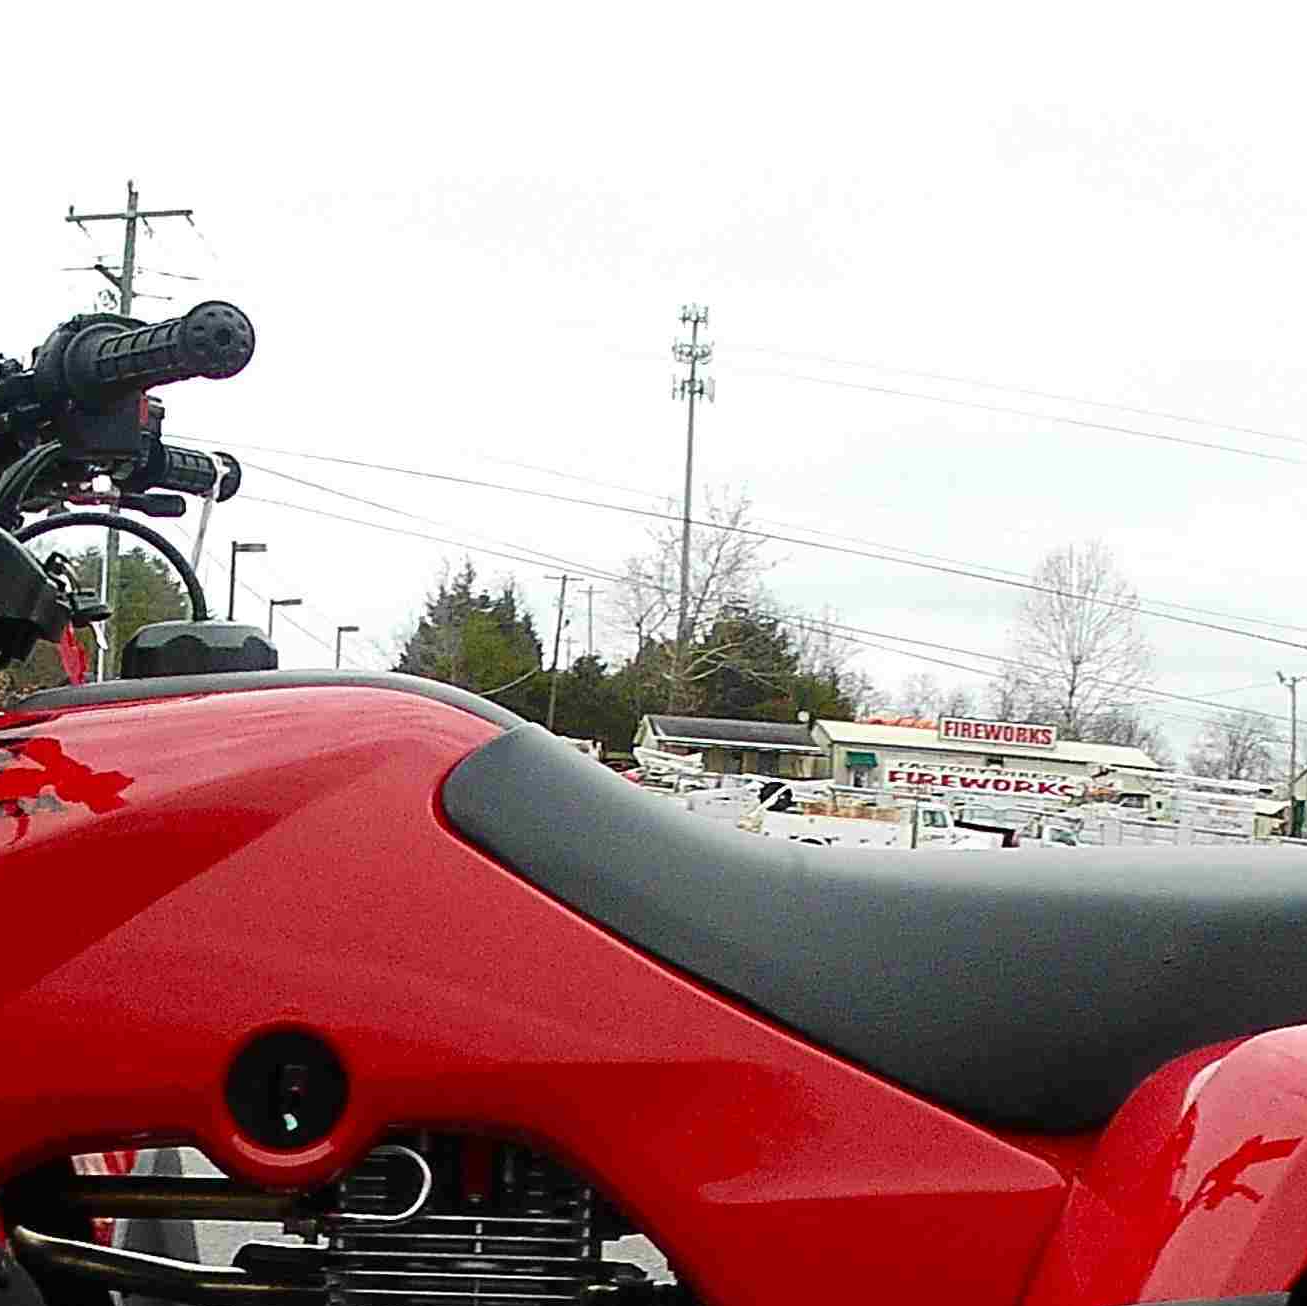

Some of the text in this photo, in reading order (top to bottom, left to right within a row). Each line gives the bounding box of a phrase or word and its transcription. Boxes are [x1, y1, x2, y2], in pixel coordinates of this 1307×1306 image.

[943, 720, 1054, 746] FIREWORKS
[897, 761, 990, 777] FACTORY
[887, 769, 1078, 799] FIREWORKS
